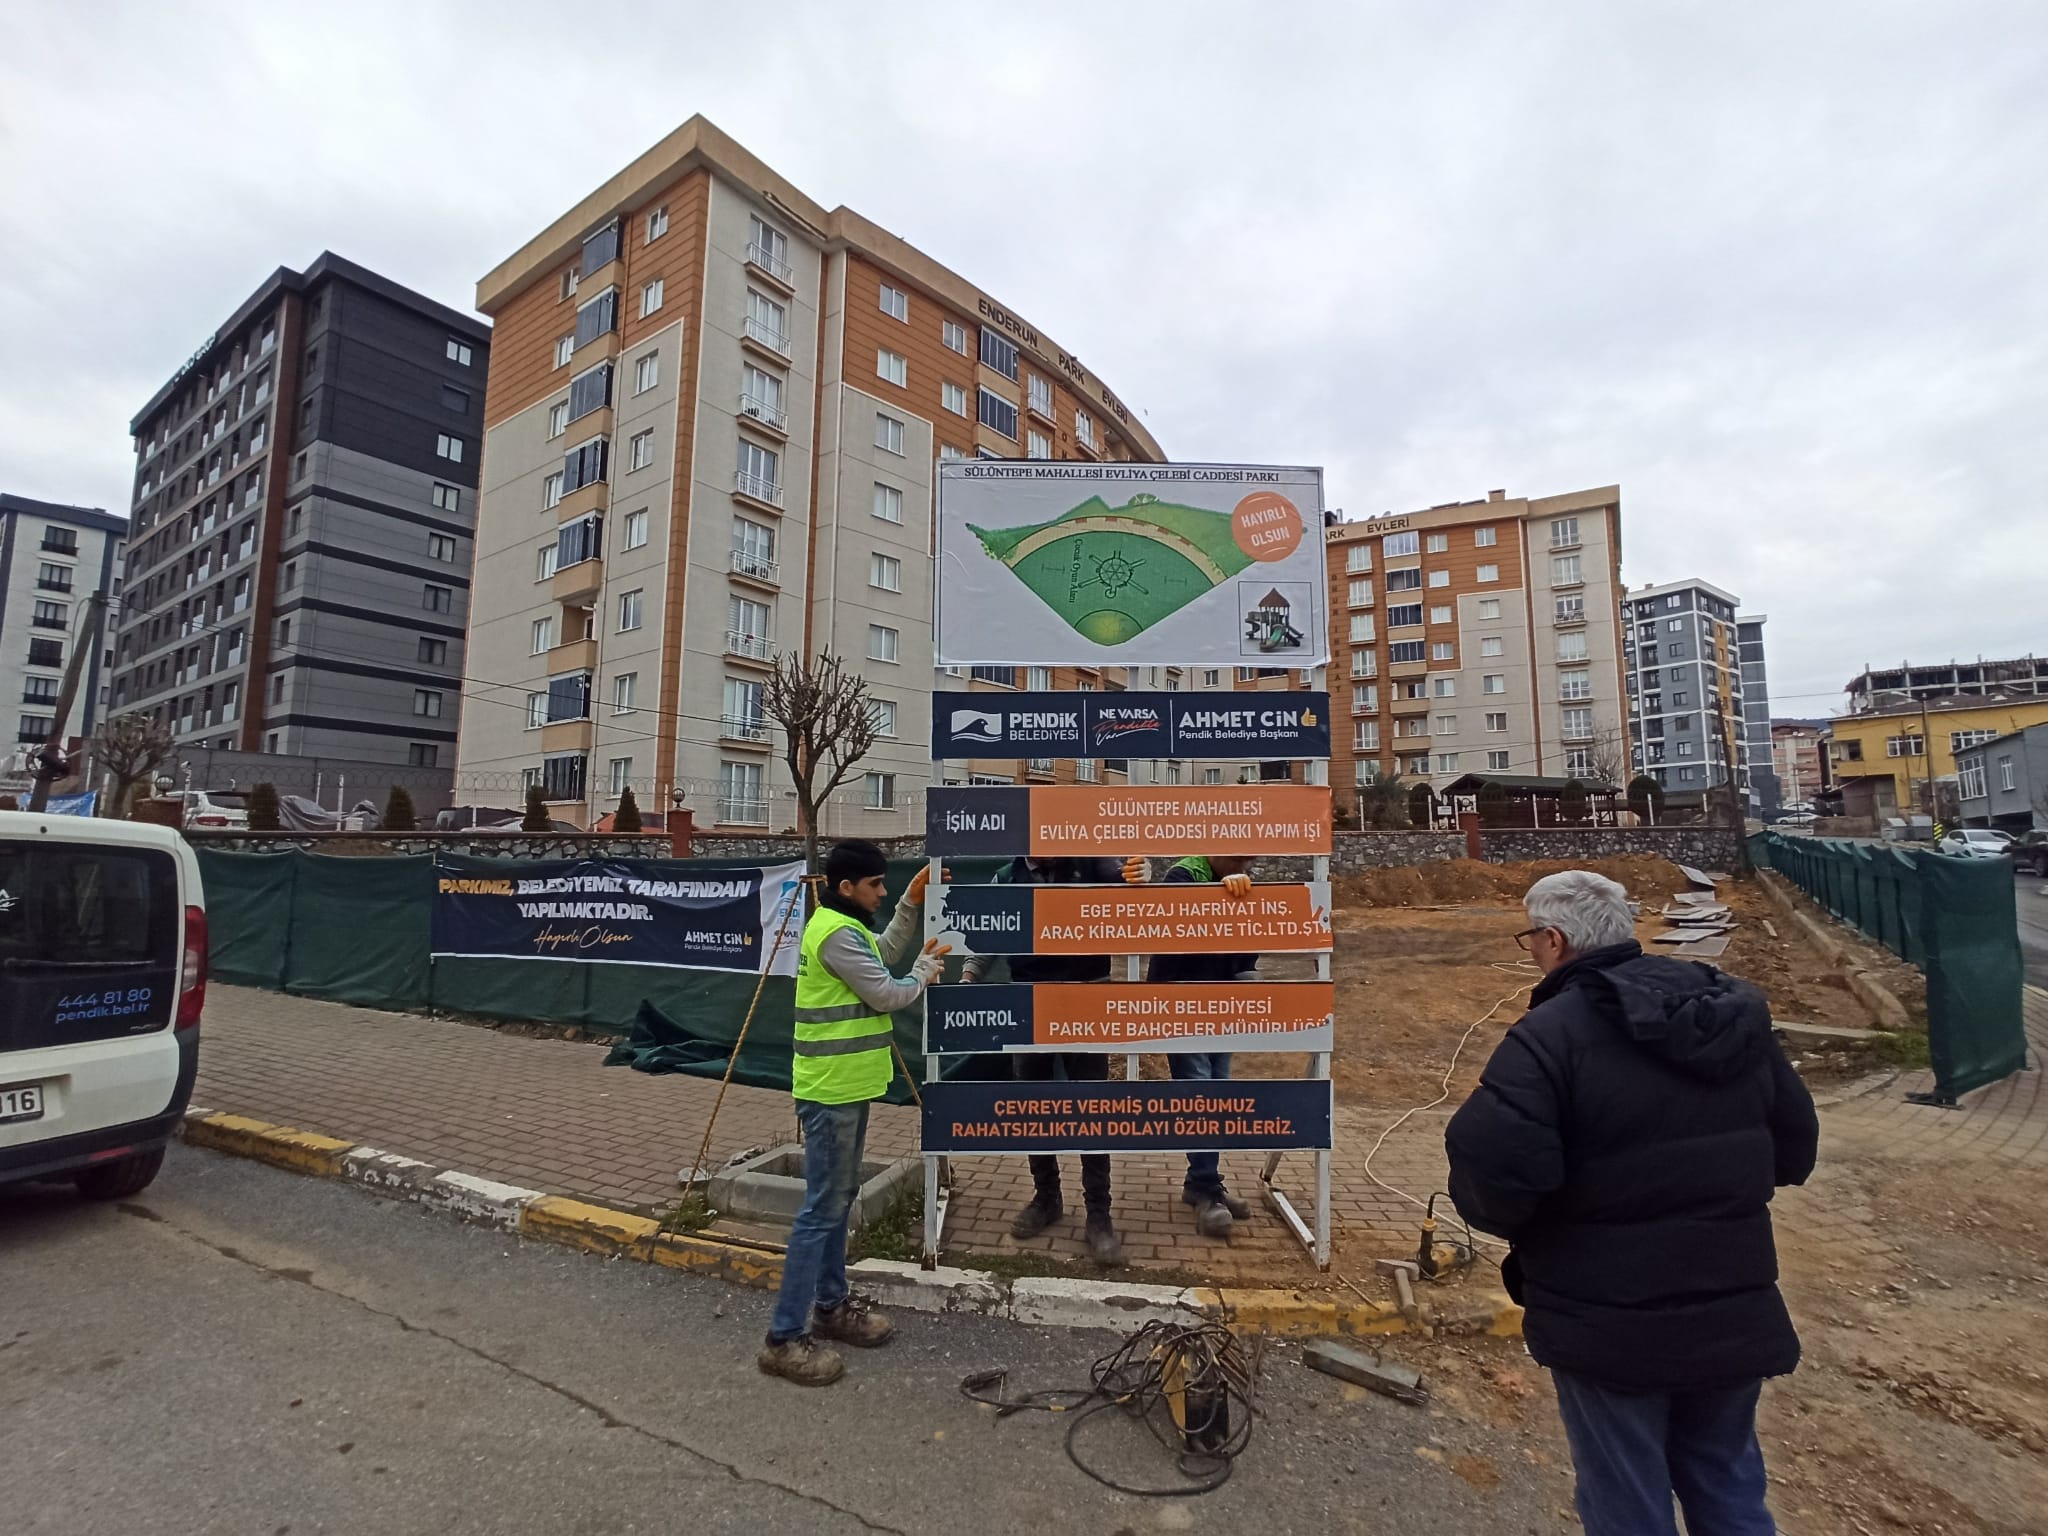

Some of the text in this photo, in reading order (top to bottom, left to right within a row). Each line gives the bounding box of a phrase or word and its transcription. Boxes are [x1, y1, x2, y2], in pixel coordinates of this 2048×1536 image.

[978, 298, 1038, 348] ENDERUN
[1058, 353, 1085, 385] PARK
[1035, 466, 1102, 479] MAHALLESİ
[1105, 467, 1148, 480] EVLİYA
[1149, 468, 1191, 482] ÇELEBİ
[1193, 469, 1243, 482] CADDESİ
[1246, 471, 1279, 482] PARKI
[1241, 505, 1287, 529] HAYIRLI
[1250, 526, 1291, 549] OLSUN
[1325, 528, 1345, 541] RK
[1099, 708, 1159, 719] NE VARSA
[1179, 711, 1256, 728] AHMET
[1179, 729, 1299, 740] Pendik Belediye Başkanı
[1098, 797, 1263, 817] SÜLÜNTEPE MAHALLESİ
[946, 810, 1006, 833] İŞİN ADI
[1040, 820, 1321, 844] EVLİYA ÇELEBİ CADDESİ PARKI YAPIM İŞİ
[627, 879, 751, 898] TARAFINDAN
[517, 902, 654, 921] YAPILMAKTADIR.
[1080, 898, 1293, 918] EGE PEYZAJ HAFRİYAT İNŞ.
[946, 910, 1021, 931] ÜKLENİCİ
[684, 931, 722, 943] AHMET
[1040, 925, 1084, 941] ARAÇ
[1089, 921, 1172, 939] KİRALAMA
[58, 988, 152, 1008] 444 81 80
[1106, 996, 1272, 1014] PENDİK BELEDİYESİ
[55, 1003, 150, 1024] pendik.bel.tr
[944, 1010, 1018, 1030] KONTROL
[1050, 1021, 1095, 1037] PARK
[1099, 1021, 1121, 1037] VE
[1126, 1020, 1216, 1038] BAHÇELER
[0, 1091, 35, 1114] 16
[994, 1094, 1256, 1117] ÇEVREYE VERMİŞ OLDUĞUMUZ
[952, 1116, 1296, 1138] RAHATSIZLIKTAN DOLAYI ÖZÜR DİLERİZ.
